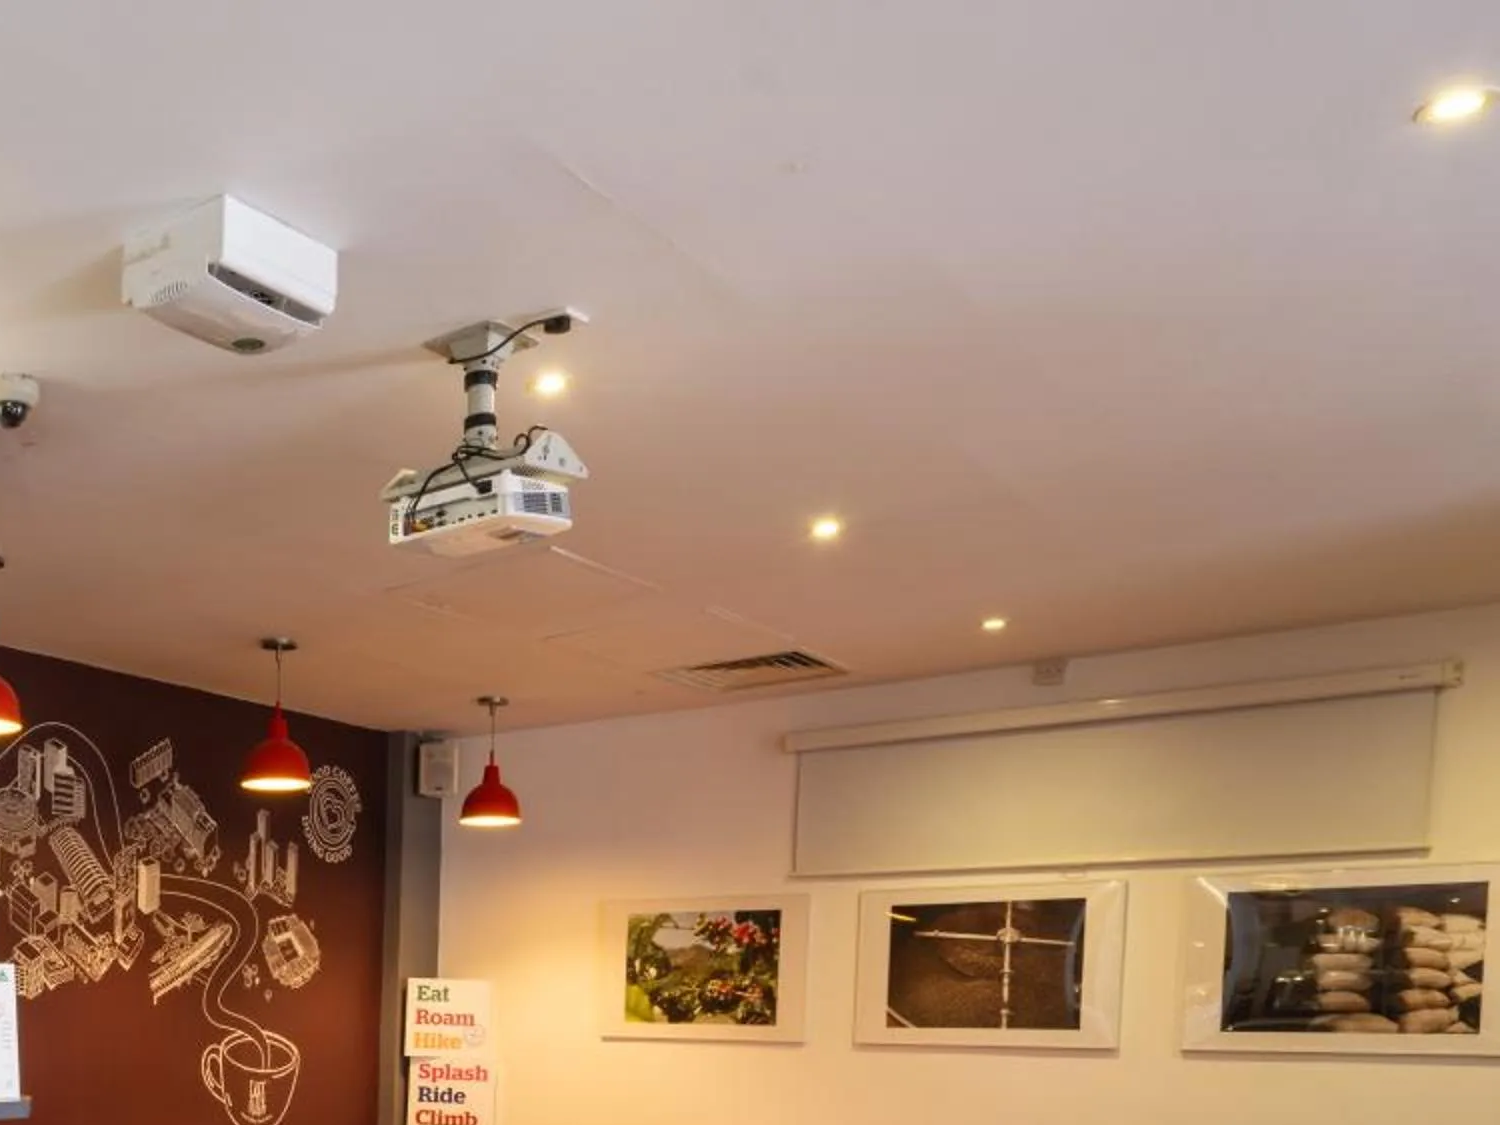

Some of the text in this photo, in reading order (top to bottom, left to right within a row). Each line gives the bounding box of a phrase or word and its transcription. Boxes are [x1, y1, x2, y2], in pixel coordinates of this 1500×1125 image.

[416, 985, 450, 1002] Eat
[415, 1009, 475, 1027] Roam
[413, 1031, 463, 1050] Hike
[418, 1063, 489, 1083] Splash
[417, 1086, 467, 1104] Ride
